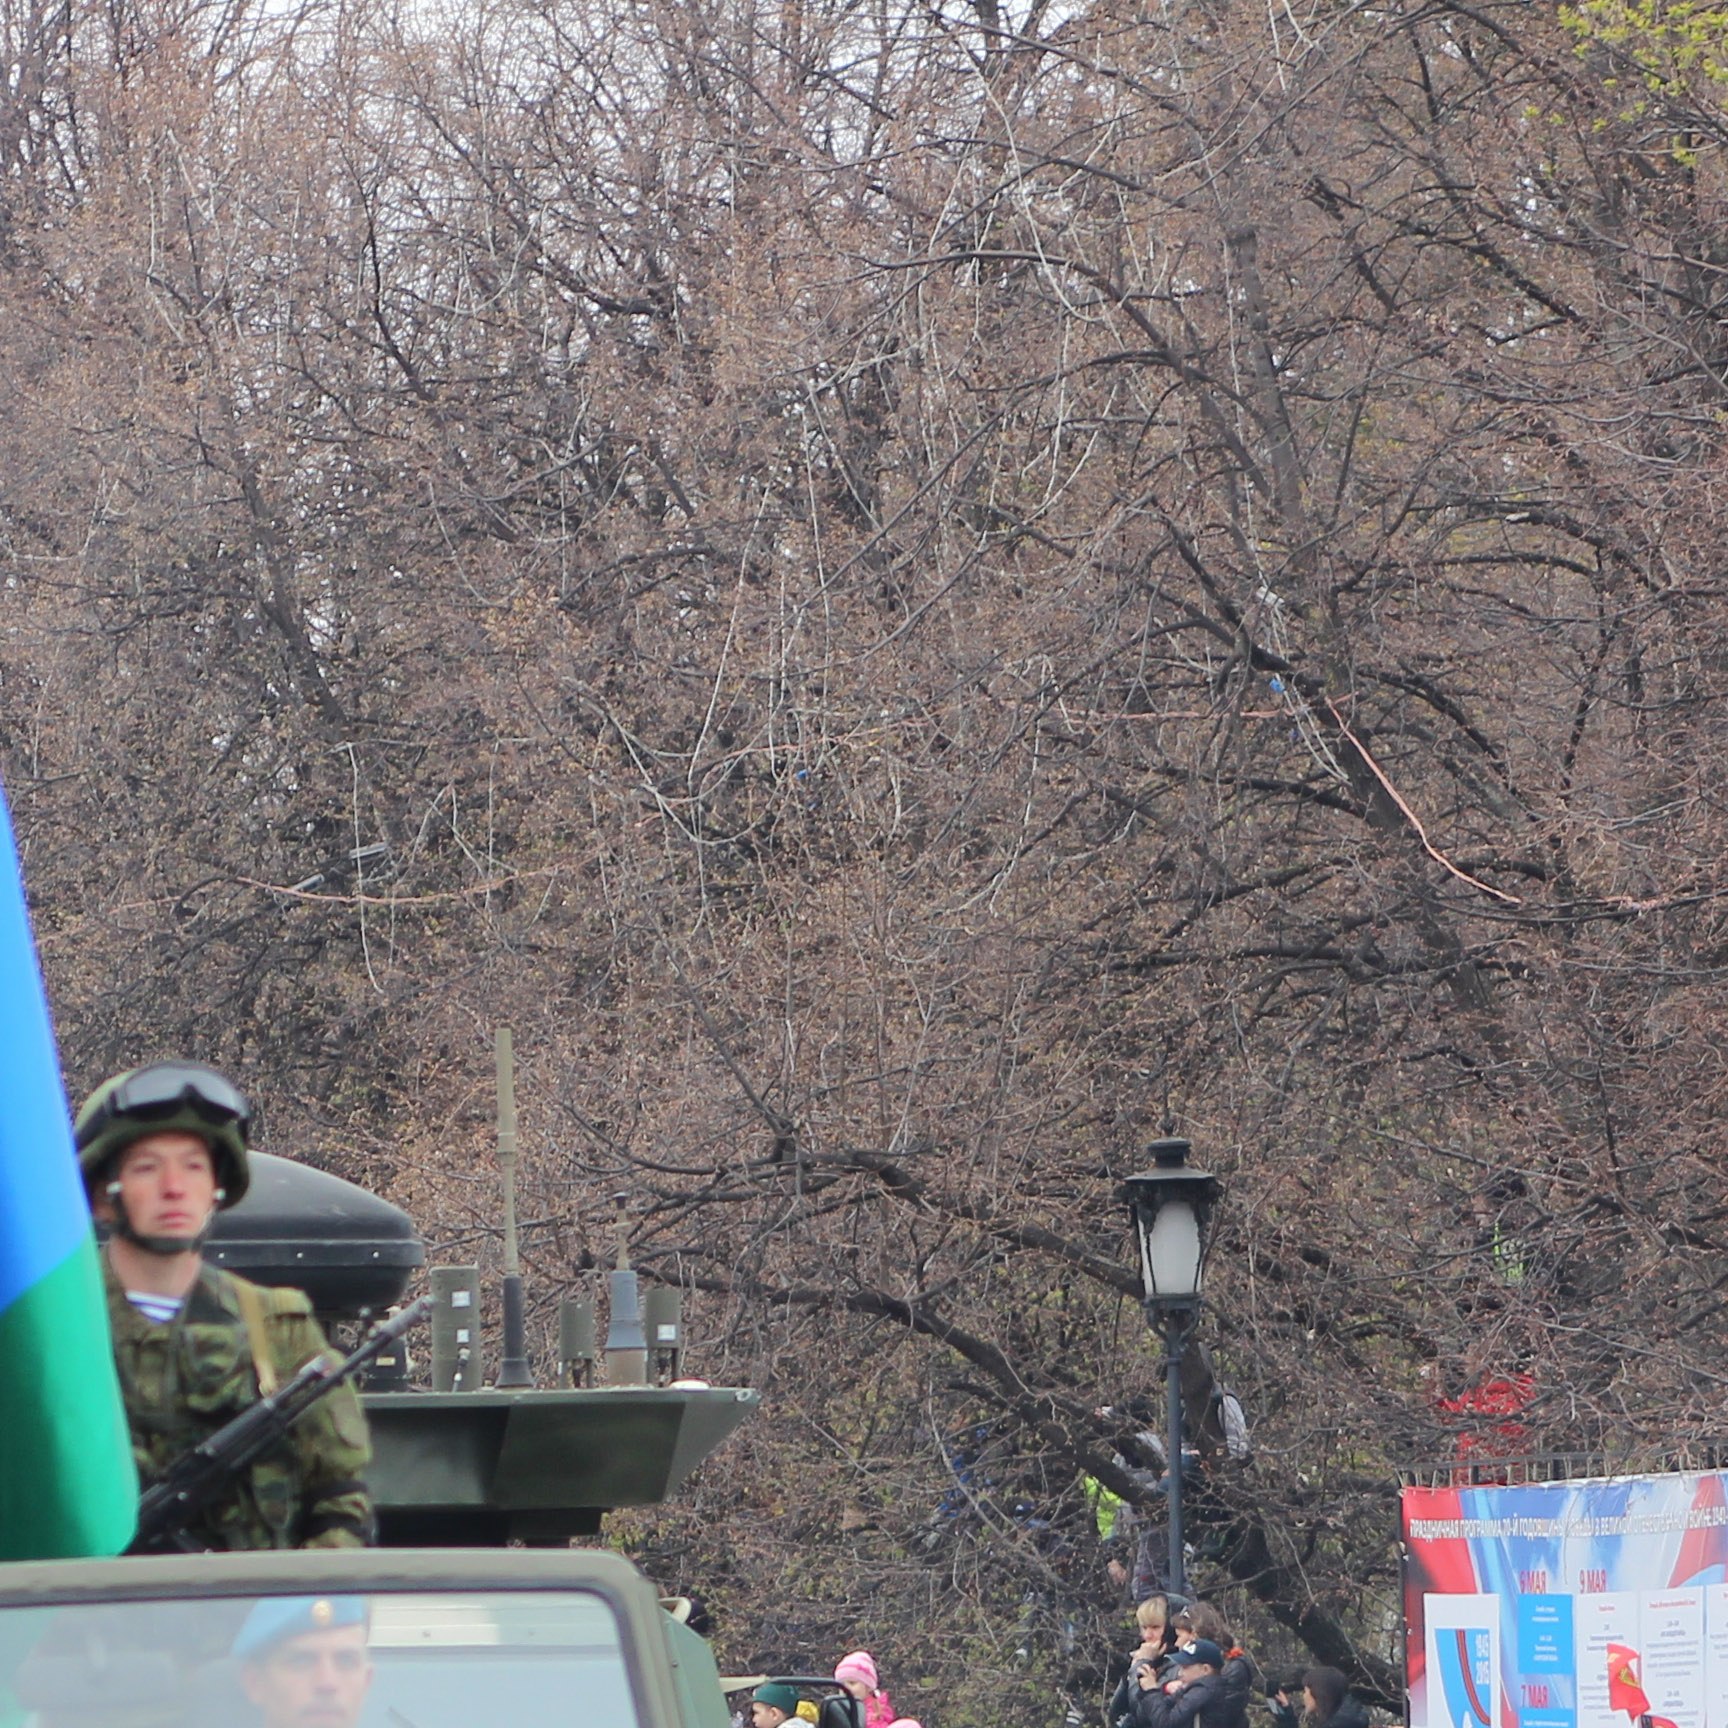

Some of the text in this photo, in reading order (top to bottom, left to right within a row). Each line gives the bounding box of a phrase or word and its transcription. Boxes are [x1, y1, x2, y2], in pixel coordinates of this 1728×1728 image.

[1459, 1518, 1501, 1538] ПРОГРАММА
[1527, 1571, 1546, 1594] МАЯ
[1579, 1570, 1606, 1594] 9 МАЯ
[1521, 1685, 1548, 1709] 7 МАЯ
